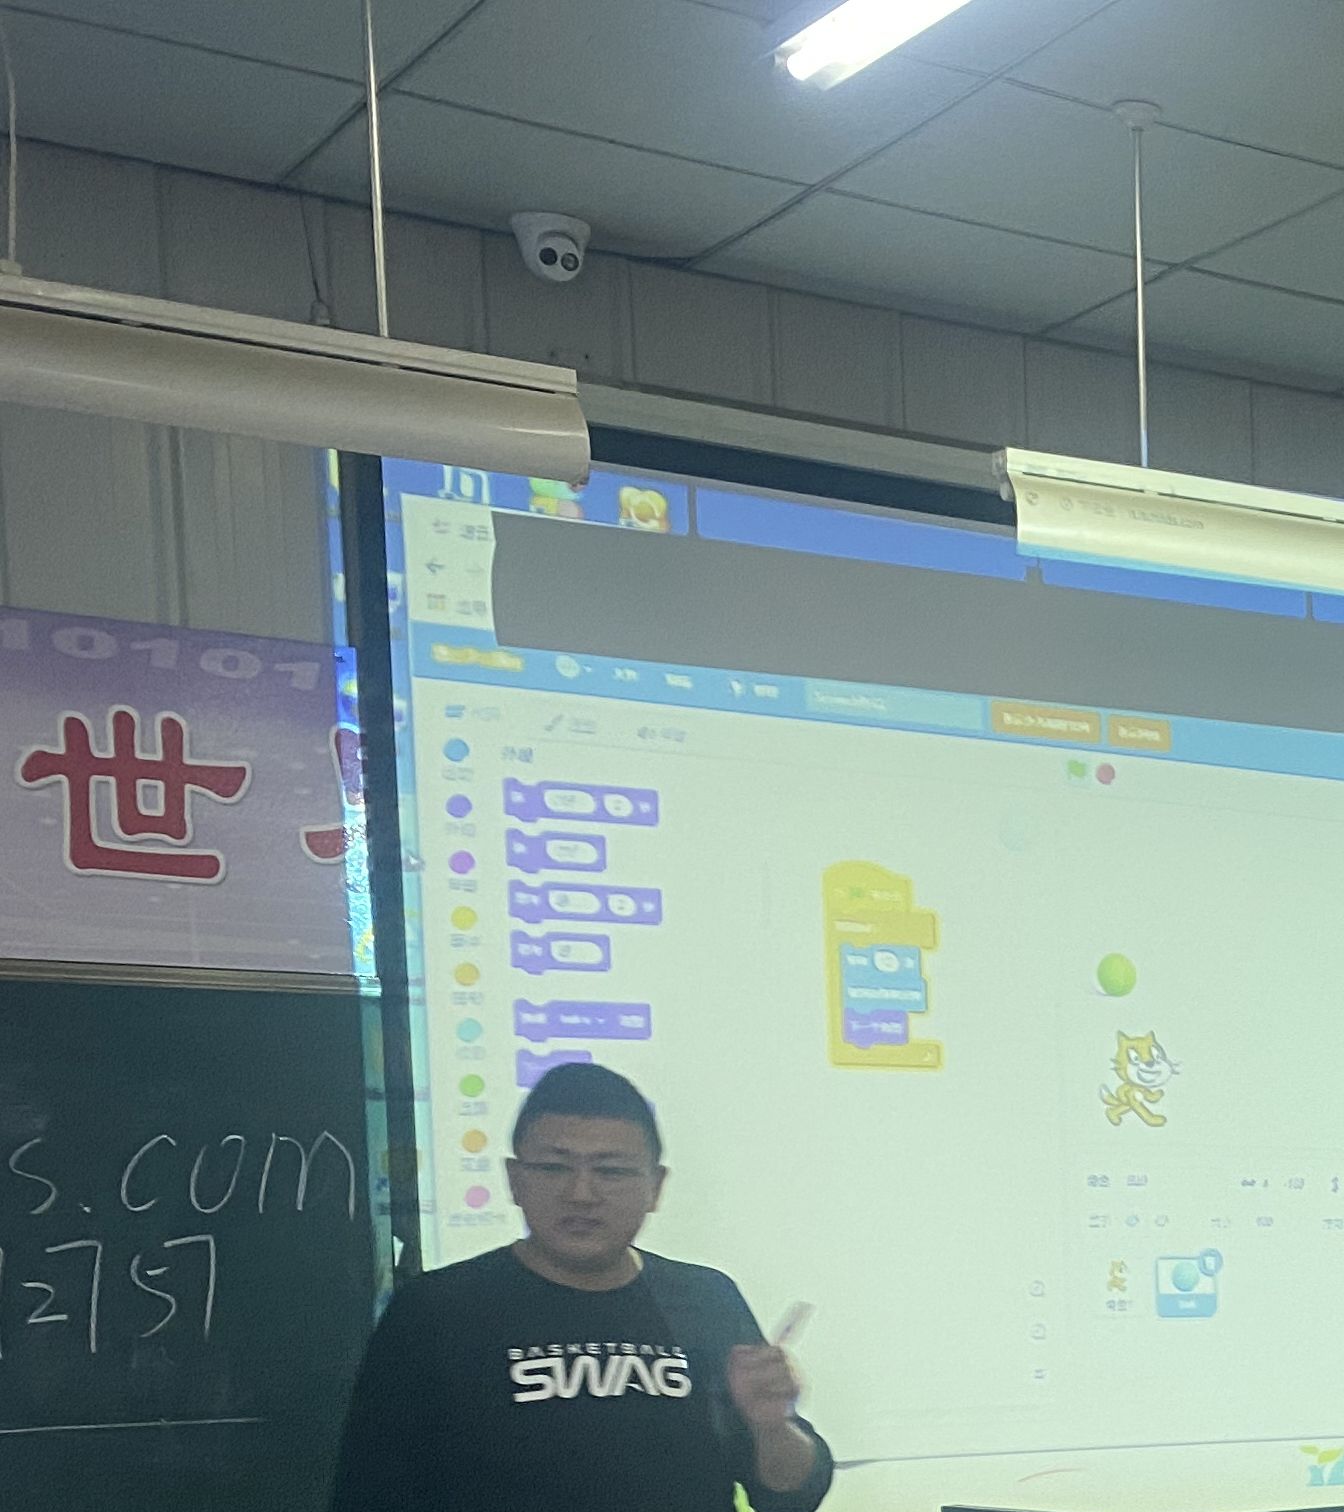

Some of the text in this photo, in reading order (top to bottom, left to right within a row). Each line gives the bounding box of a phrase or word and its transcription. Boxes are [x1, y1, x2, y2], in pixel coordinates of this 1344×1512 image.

[15, 704, 360, 884] 世
[508, 1342, 687, 1360] BASKETBALL
[510, 1355, 692, 1402] SWAG
